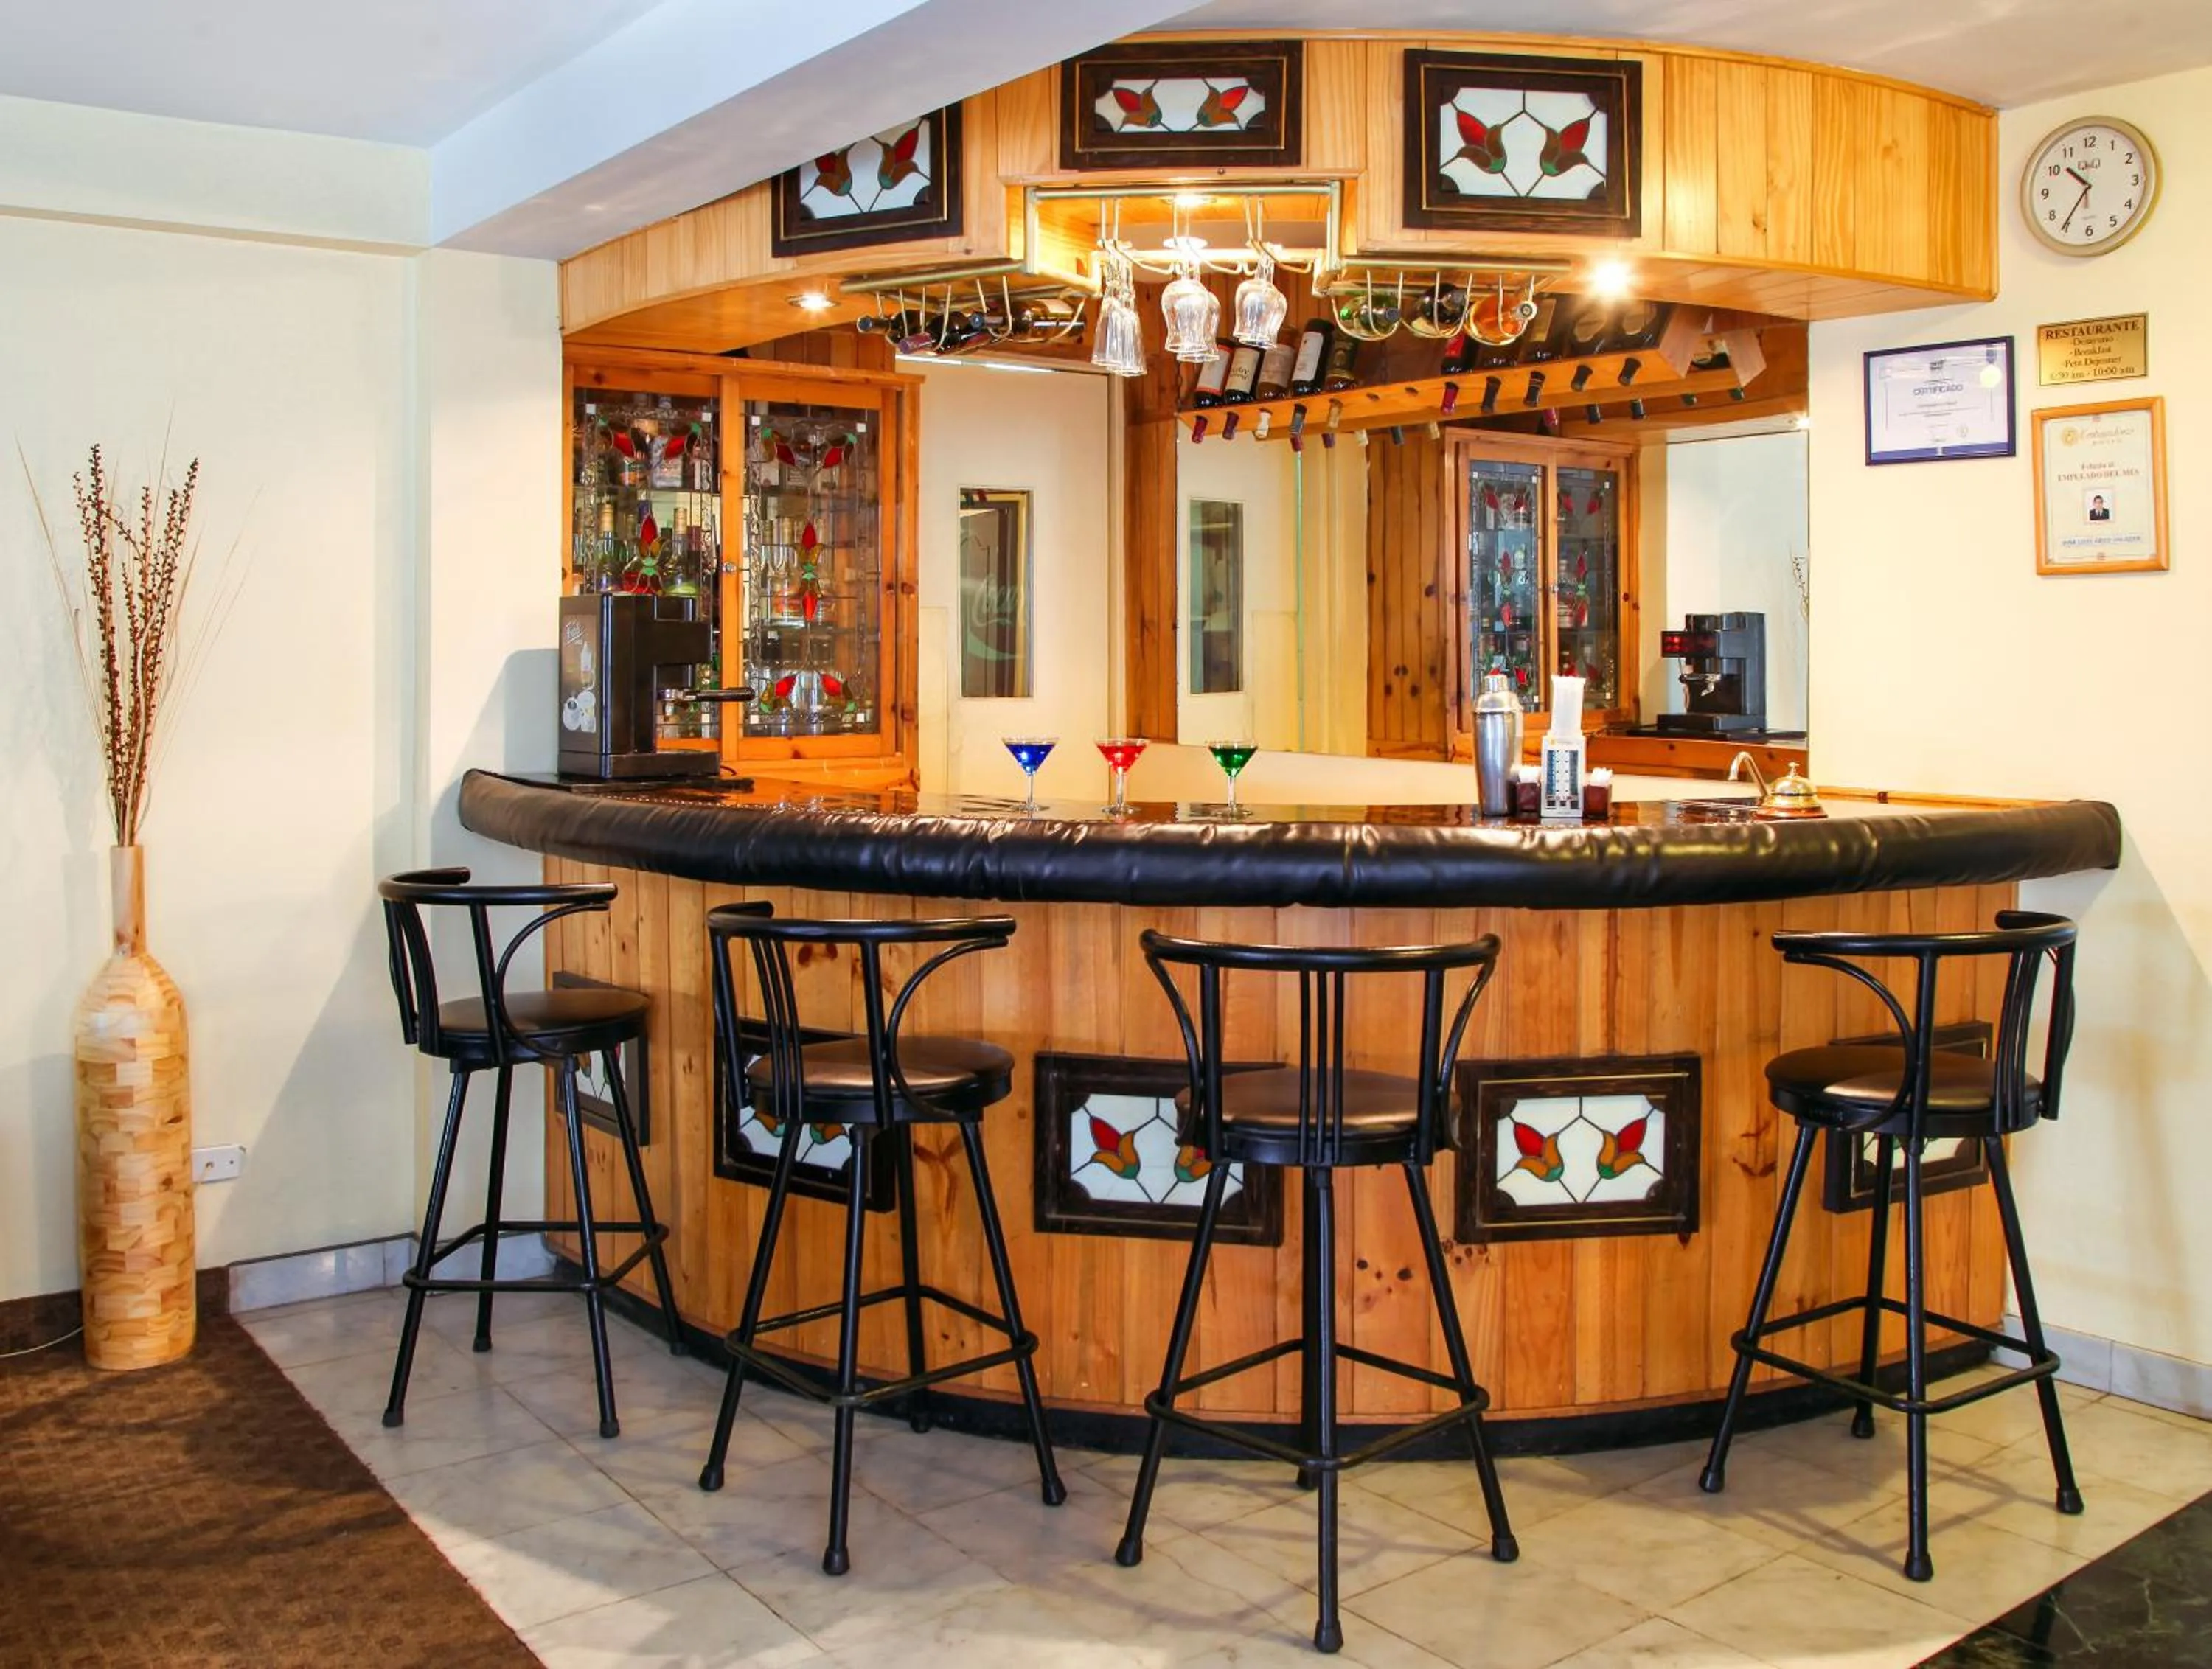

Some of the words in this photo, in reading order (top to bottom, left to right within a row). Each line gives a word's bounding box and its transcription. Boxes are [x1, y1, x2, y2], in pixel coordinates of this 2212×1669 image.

[2084, 136, 2096, 148] 12
[2110, 140, 2115, 150] 1
[2062, 147, 2073, 158] 11
[2124, 153, 2133, 164] 2
[2048, 164, 2060, 176] 10
[2132, 175, 2139, 186] 3
[2041, 188, 2049, 199] 9
[2124, 198, 2132, 209] 4
[2048, 210, 2056, 220] 8
[2109, 215, 2117, 227] 5
[2085, 225, 2093, 236] 6
[2045, 321, 2140, 340] RESTAURANTE
